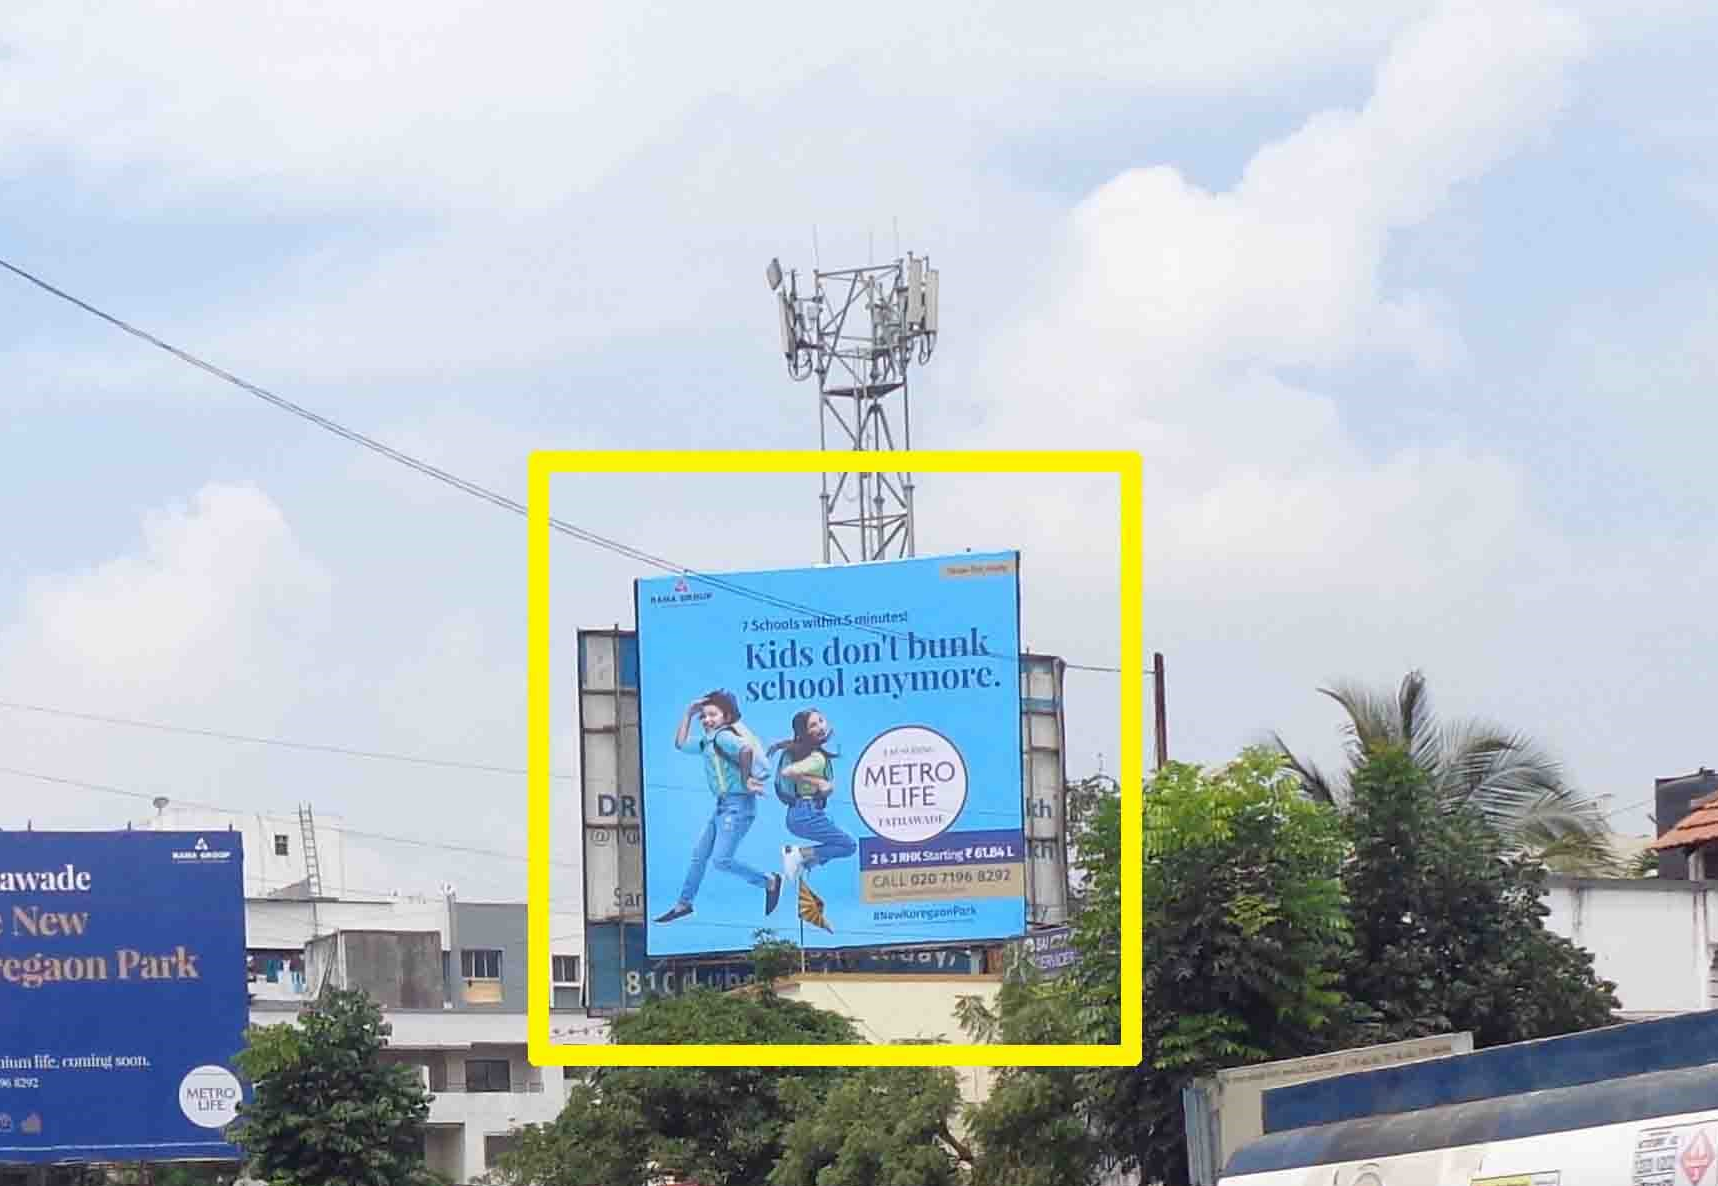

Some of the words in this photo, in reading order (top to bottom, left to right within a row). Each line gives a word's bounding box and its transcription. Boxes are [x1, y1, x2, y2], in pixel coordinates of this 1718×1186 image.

[750, 617, 801, 632] Schools
[801, 615, 842, 629] within
[854, 611, 908, 626] minutes!
[746, 639, 813, 671] Kids
[823, 633, 900, 666] don't
[907, 628, 990, 660] bunk
[745, 668, 845, 702] school
[854, 667, 1001, 700] anymore.
[865, 761, 956, 787] METRO
[886, 785, 937, 808] LIFE
[922, 849, 964, 863] Starting
[872, 875, 907, 889] CALL
[910, 873, 937, 886] 020
[941, 870, 972, 884] 7196
[977, 868, 1012, 882] 8292
[11, 907, 90, 937] New
[116, 947, 200, 981] Park
[62, 1054, 112, 1072] coming
[114, 1055, 151, 1068] soon.
[186, 1087, 236, 1100] METRO
[197, 1100, 226, 1112] LIFE
